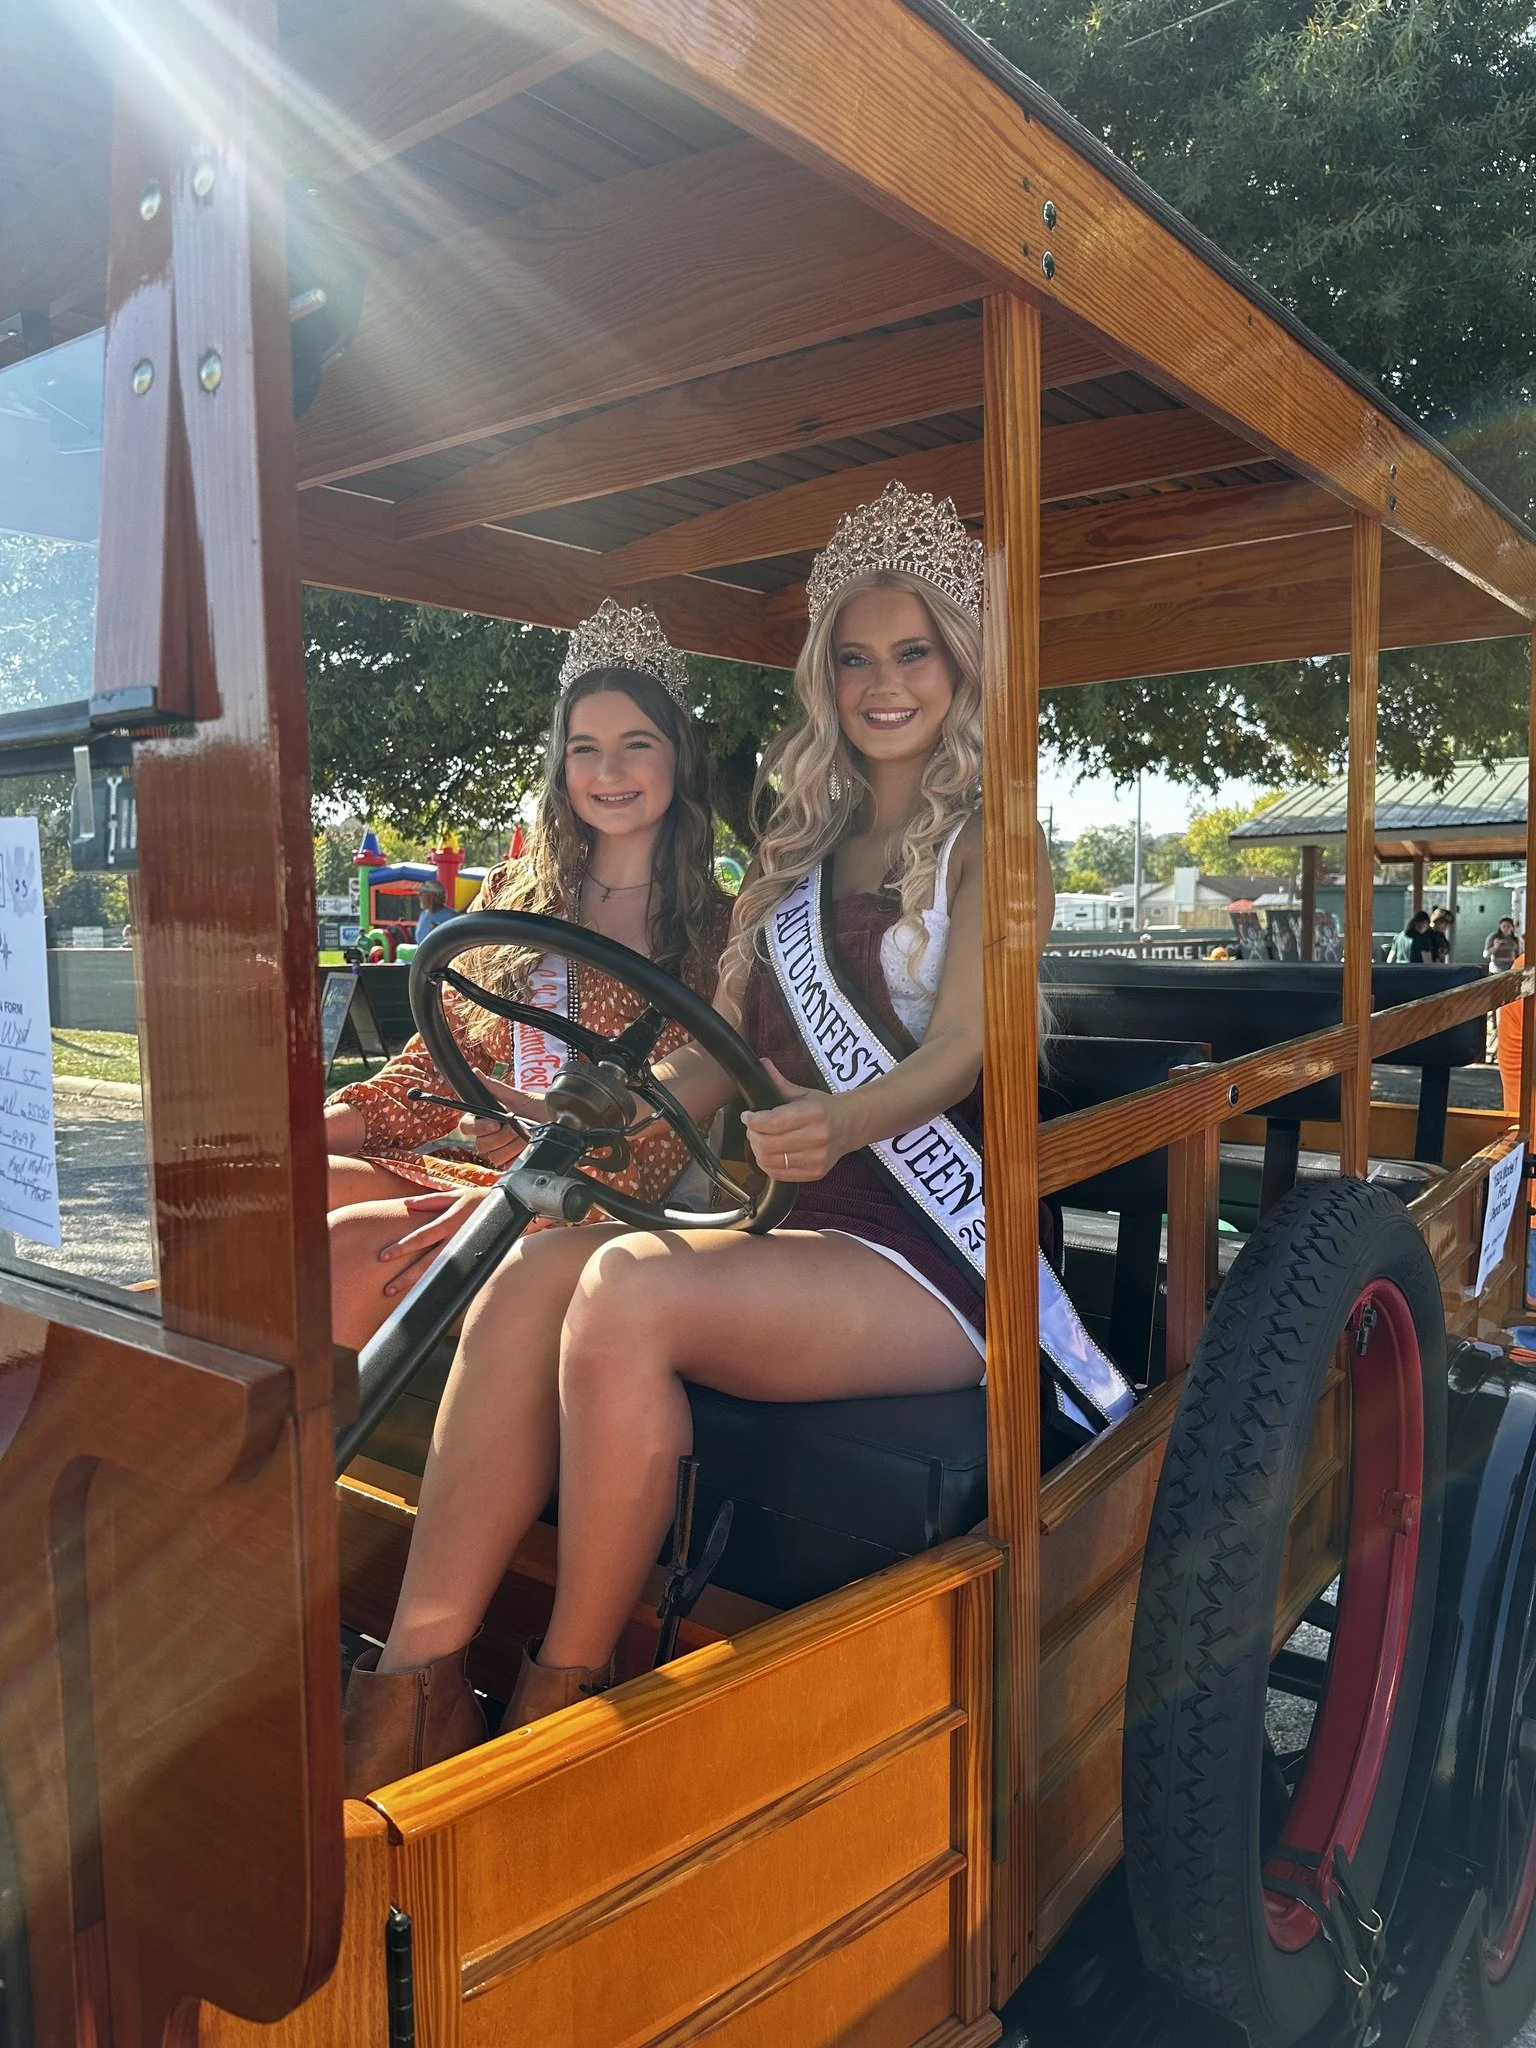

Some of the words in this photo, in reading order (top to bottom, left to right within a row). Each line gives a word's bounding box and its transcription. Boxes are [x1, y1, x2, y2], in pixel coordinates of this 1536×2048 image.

[1142, 946, 1193, 960] LITTLE
[4, 1001, 24, 1015] FORM
[891, 1125, 983, 1216] UEEN
